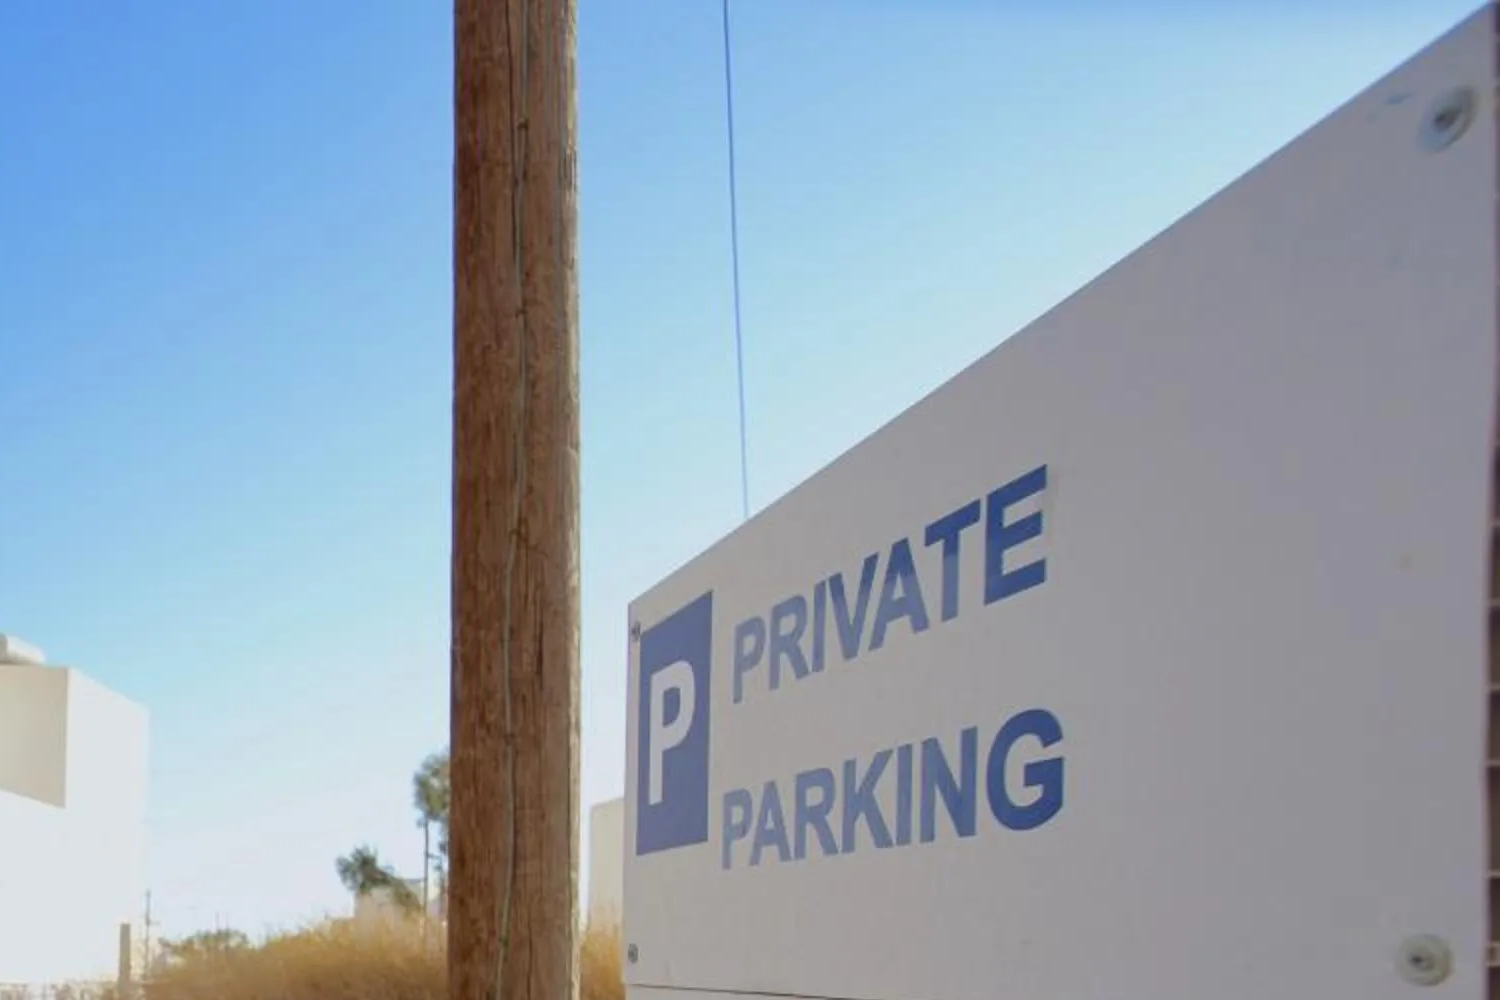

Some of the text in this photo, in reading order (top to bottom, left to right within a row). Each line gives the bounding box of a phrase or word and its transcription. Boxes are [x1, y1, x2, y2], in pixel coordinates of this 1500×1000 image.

[733, 464, 1048, 704] PRIVATE
[649, 660, 696, 805] P
[722, 708, 1065, 870] PARKING
